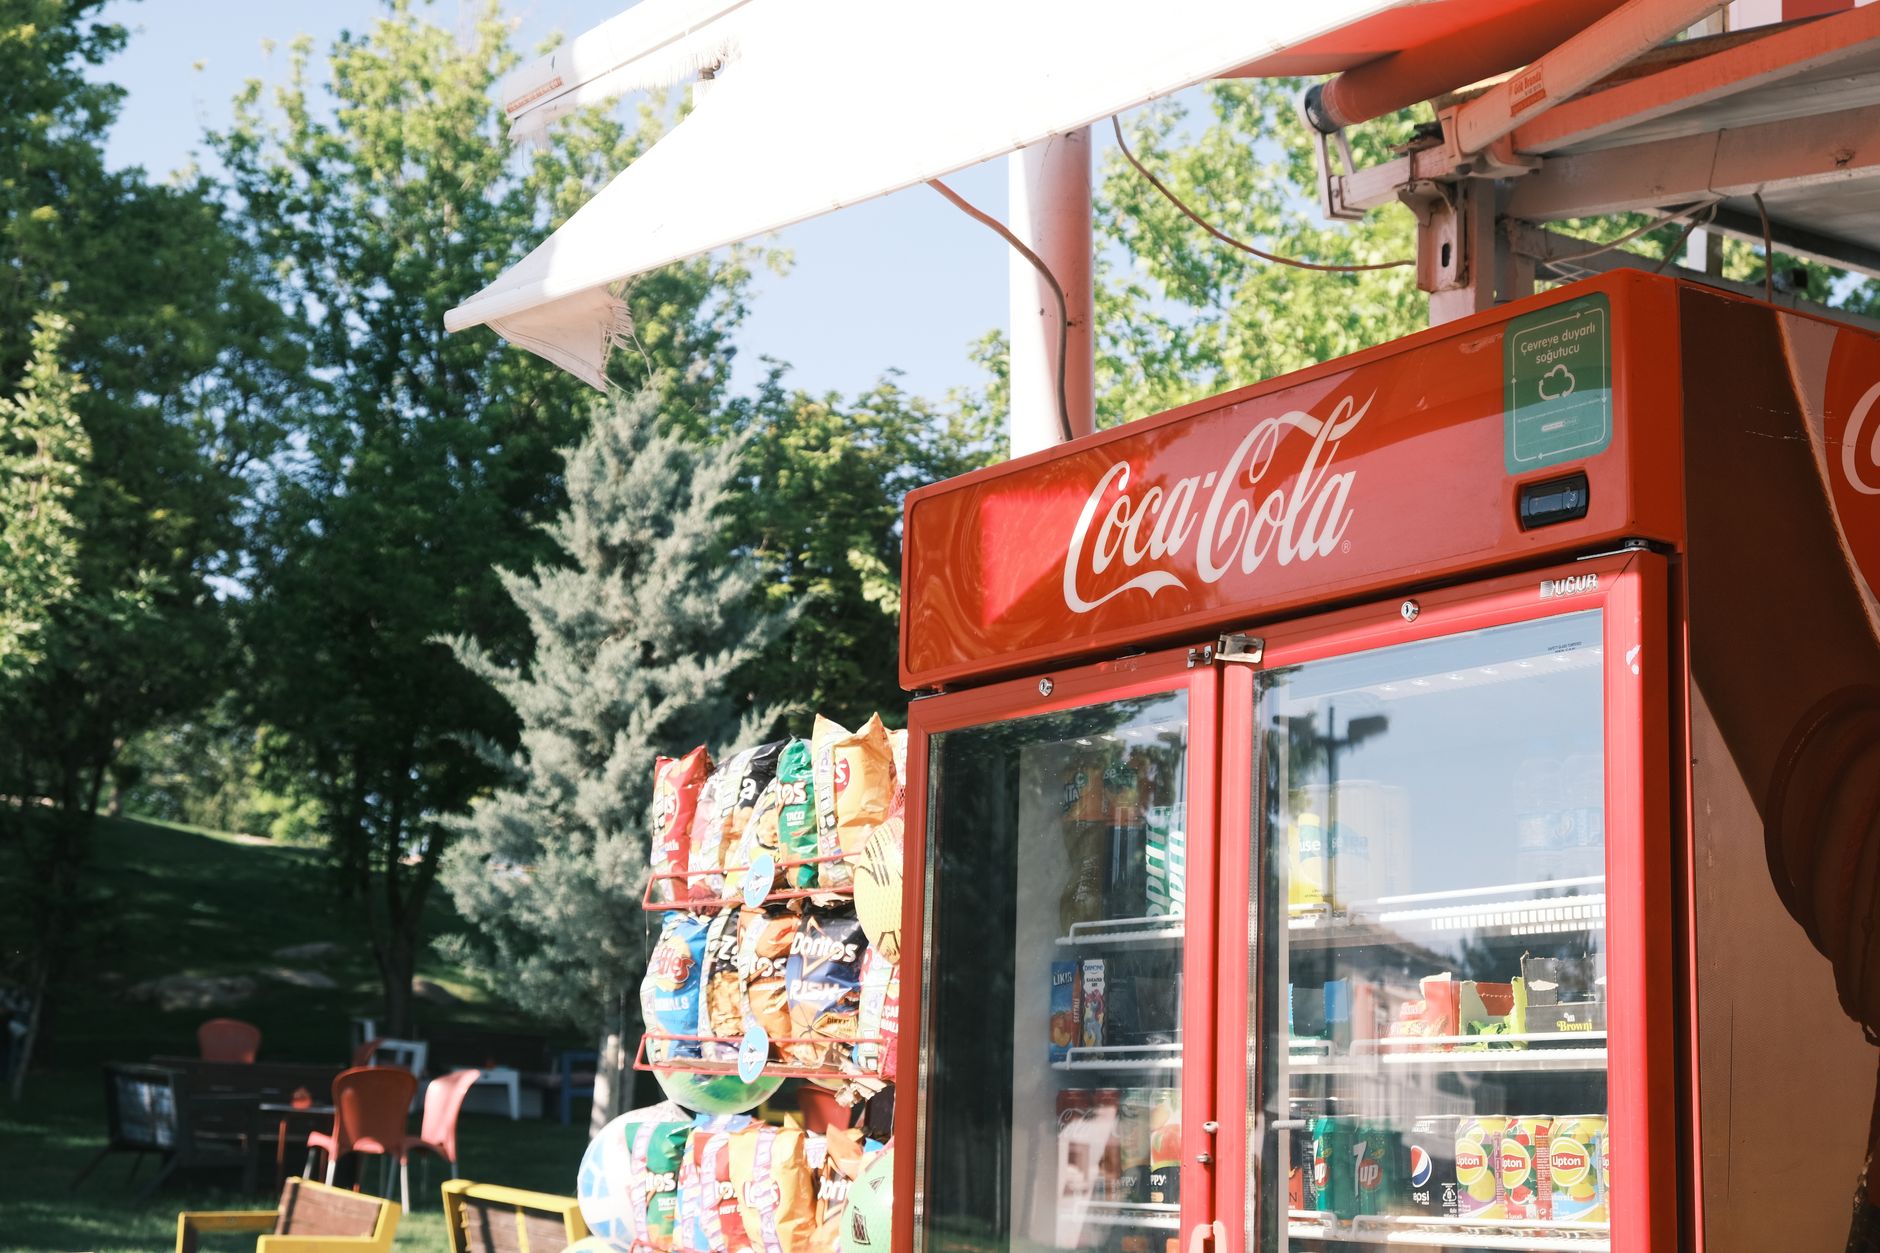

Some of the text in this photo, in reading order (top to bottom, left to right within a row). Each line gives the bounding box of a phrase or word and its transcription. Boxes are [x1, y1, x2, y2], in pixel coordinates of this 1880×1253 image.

[1521, 321, 1596, 356] Çevreye duyarlı
[1536, 344, 1580, 364] soğutucu
[1063, 388, 1378, 614] Coca-Cola
[790, 931, 859, 963] Doritos
[1552, 1156, 1581, 1168] Lipton
